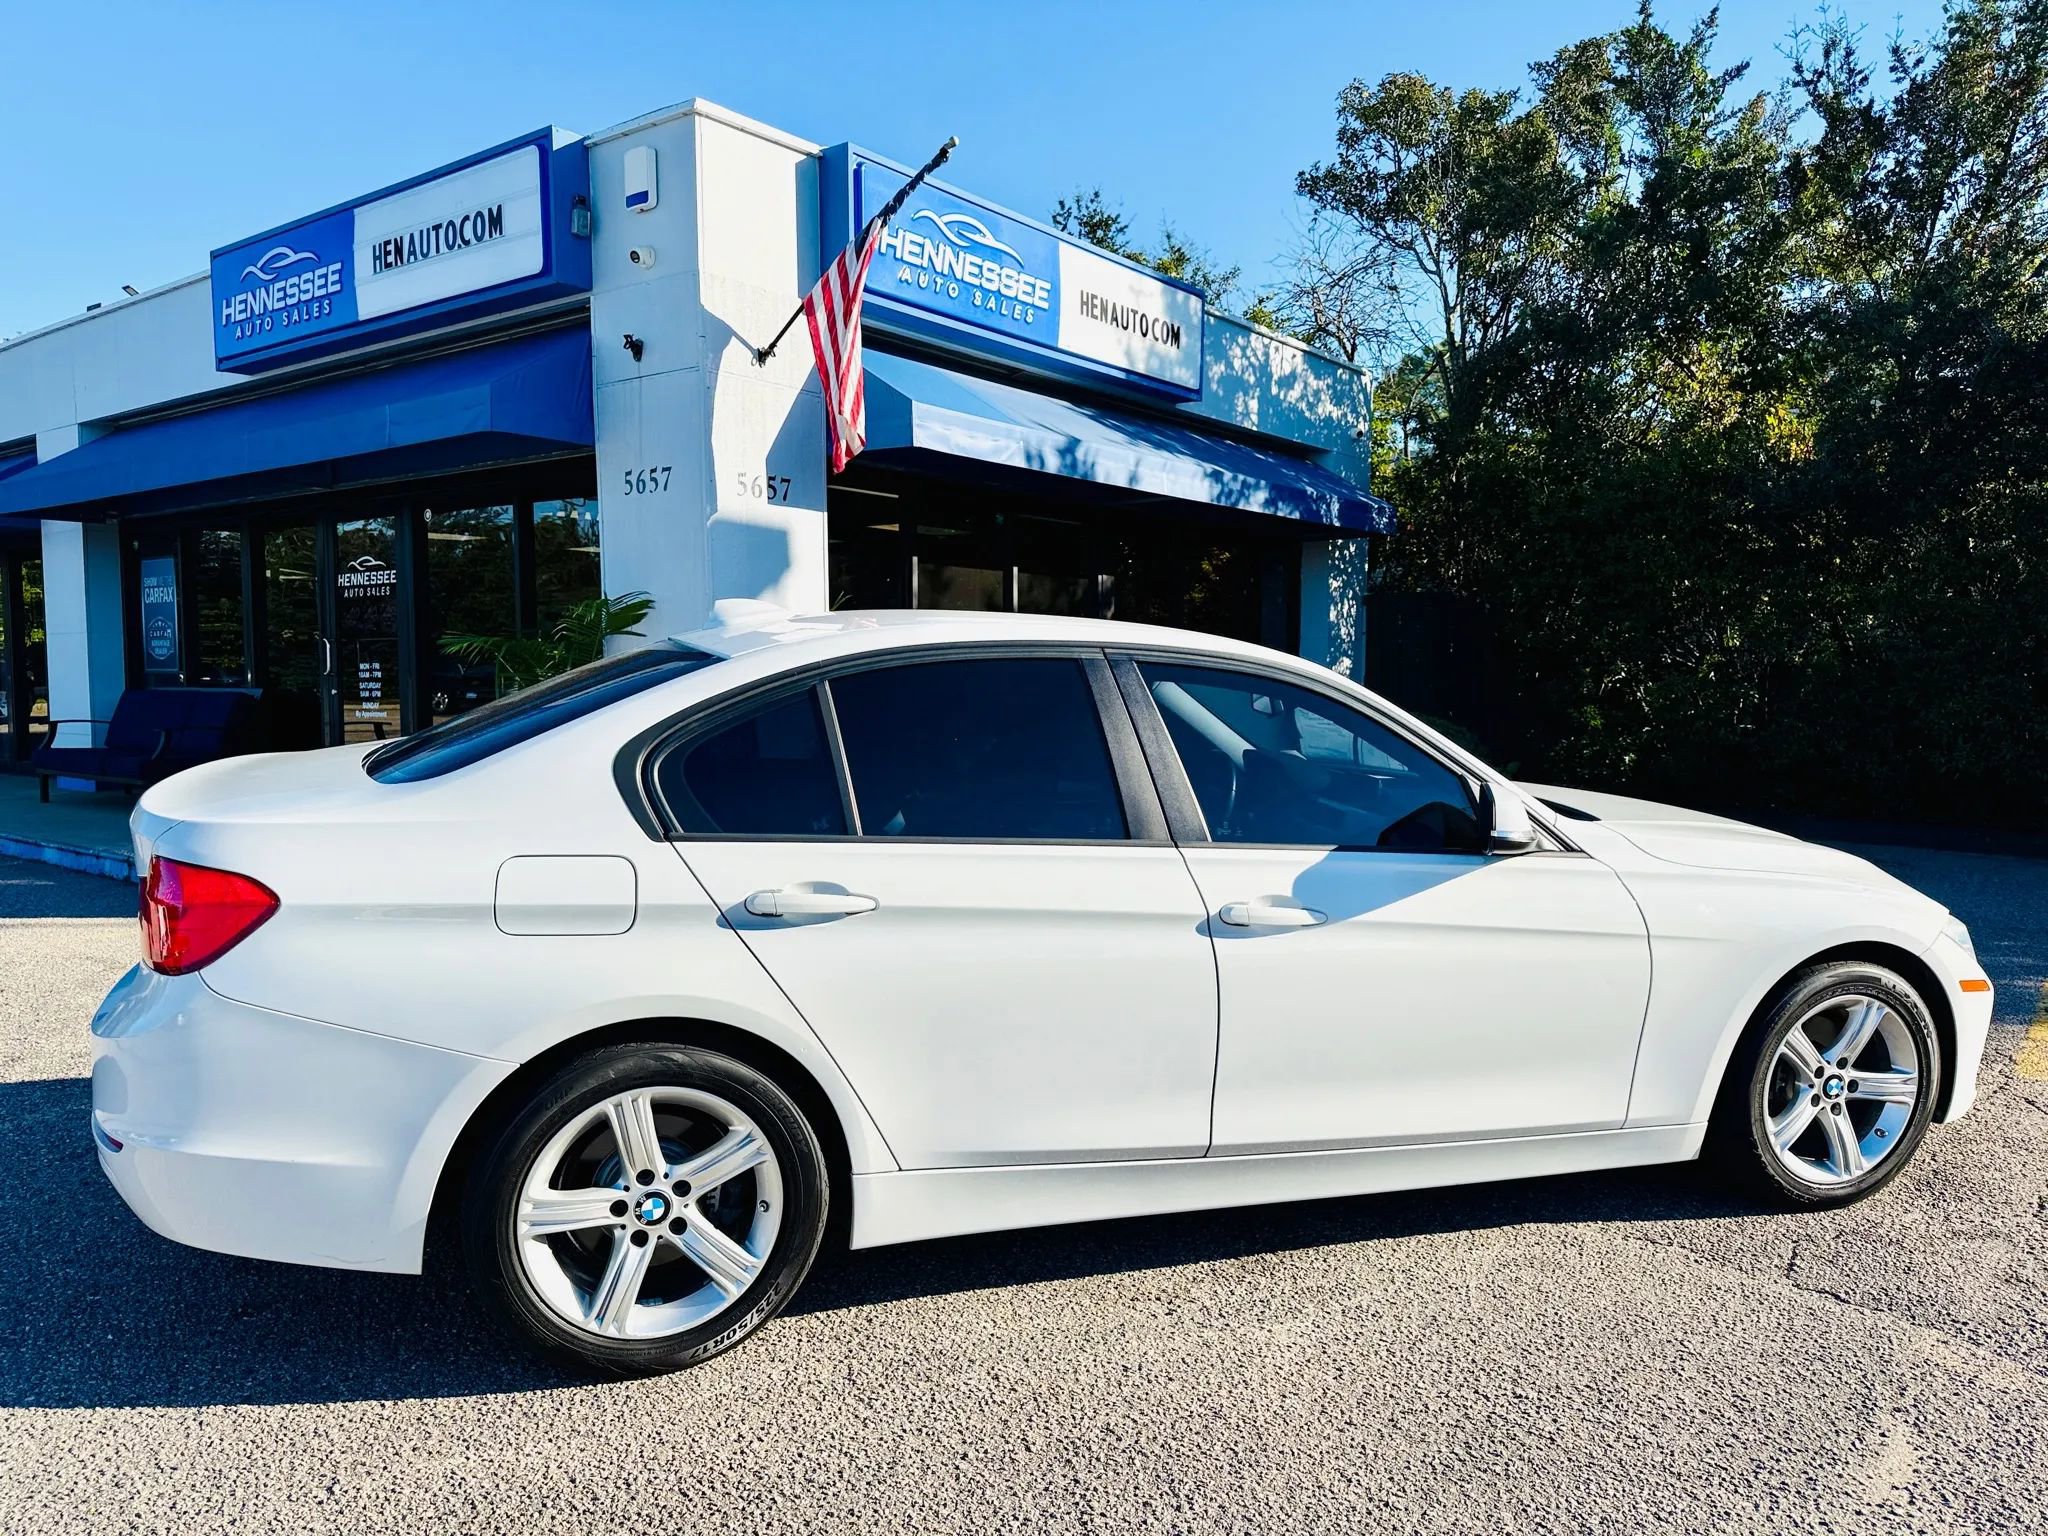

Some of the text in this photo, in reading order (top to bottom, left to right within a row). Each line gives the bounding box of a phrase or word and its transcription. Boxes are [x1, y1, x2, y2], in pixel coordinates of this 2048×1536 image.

[373, 204, 503, 274] HENAUTO.COM
[880, 226, 1052, 310] HENNESSEE
[222, 262, 342, 327] HENNESSEE
[898, 266, 1035, 325] AUTO SALES
[235, 300, 330, 340] AUTO SALES
[624, 466, 672, 496] 5657
[737, 471, 792, 502] 5657
[144, 586, 174, 604] CARFAX
[338, 569, 397, 588] HENNESSEE
[344, 586, 391, 598] AUTO SALES
